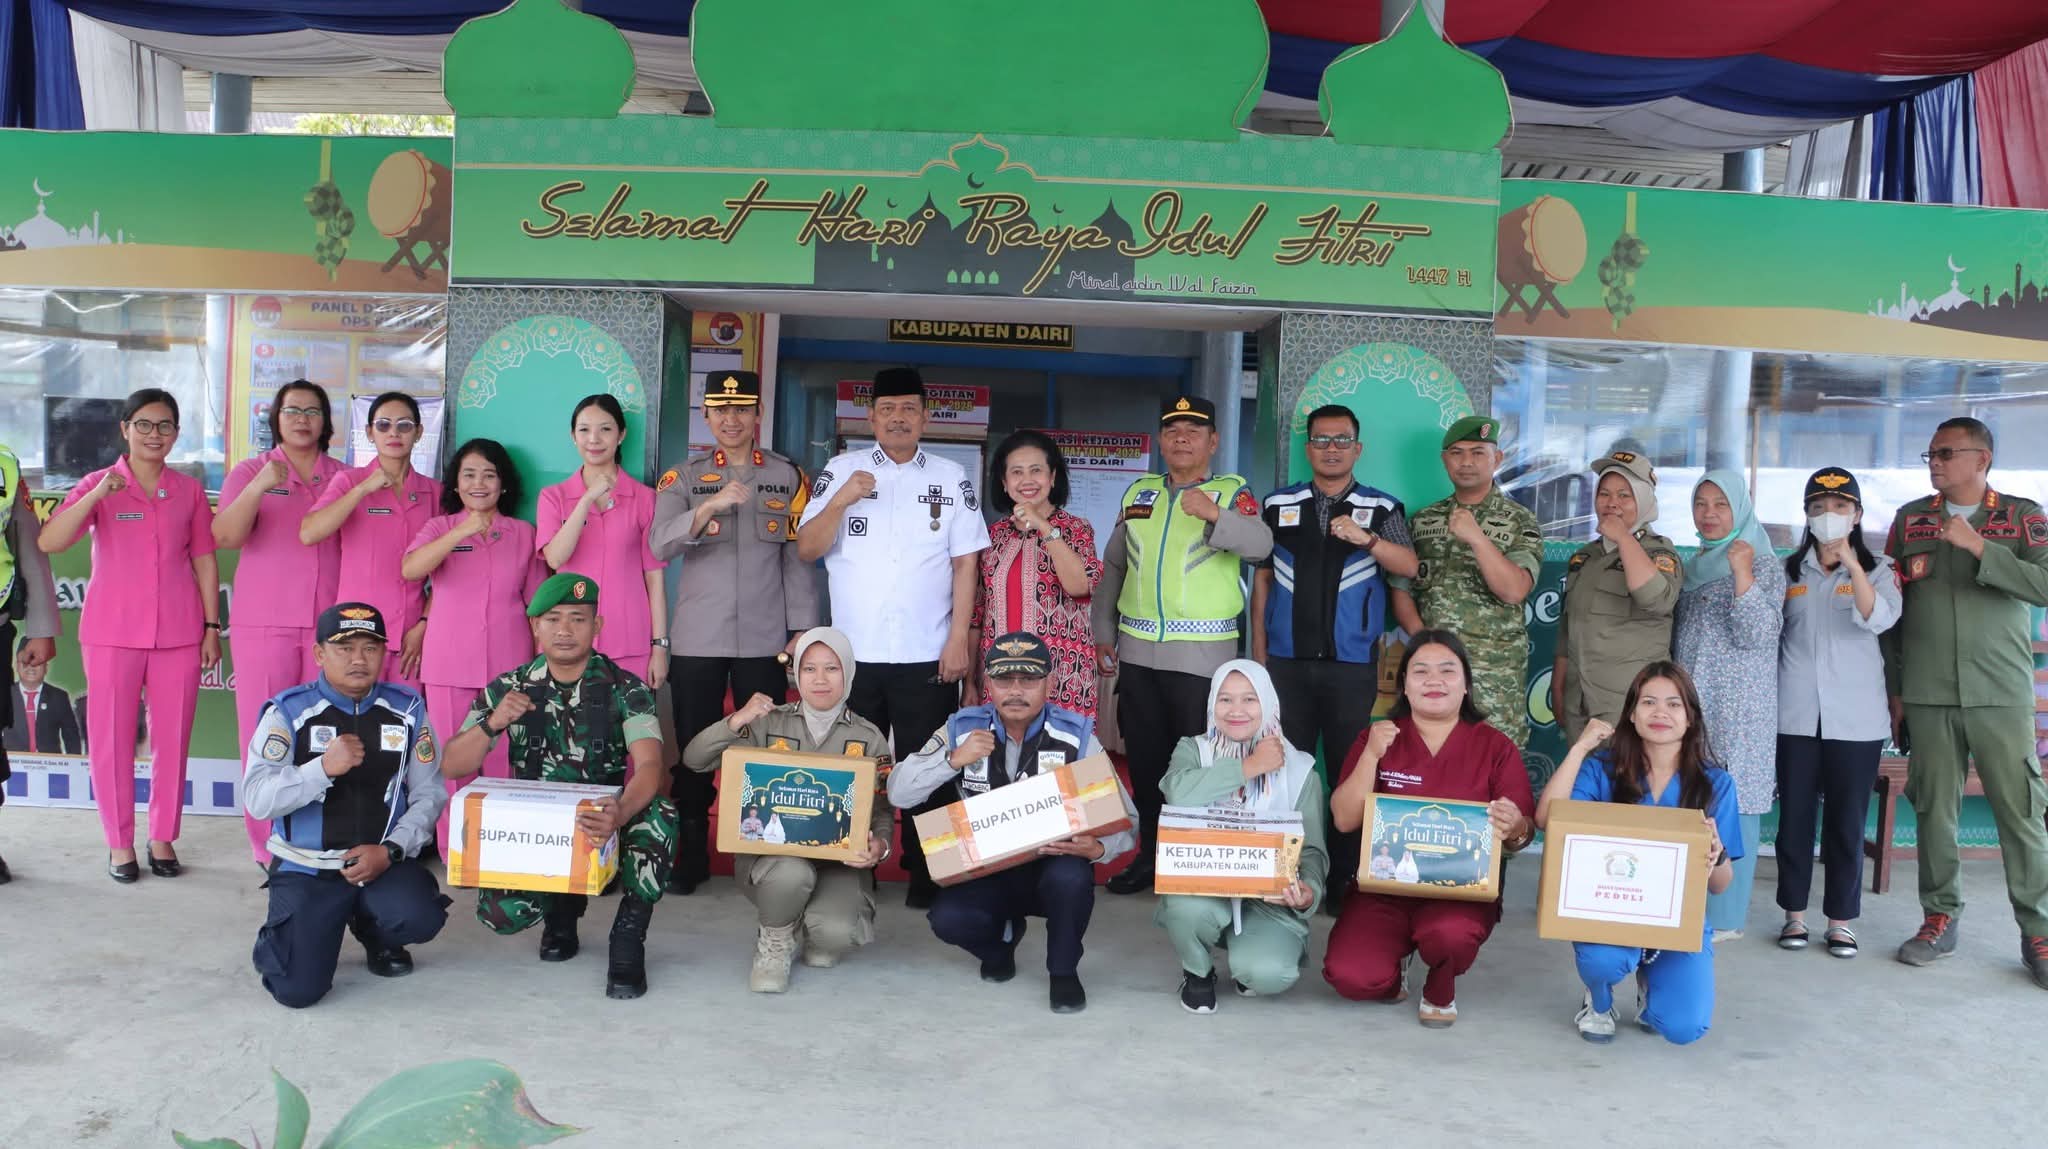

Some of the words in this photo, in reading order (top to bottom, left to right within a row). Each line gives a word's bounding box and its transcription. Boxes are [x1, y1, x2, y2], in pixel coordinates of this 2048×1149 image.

[521, 179, 817, 245] Selamat
[797, 184, 938, 246] Hari
[959, 192, 1111, 295] Raya
[1117, 190, 1269, 260] Idul
[1067, 270, 1120, 292] Minal
[1122, 275, 1164, 293] aidin
[1167, 277, 1205, 296] Wal
[1407, 266, 1447, 287] 1447
[1457, 269, 1472, 288] H
[311, 302, 358, 314] PANEL
[341, 316, 370, 328] OPS
[893, 320, 1010, 340] KABUPATEN
[1015, 325, 1069, 342] DAIRI
[931, 411, 957, 419] AIRI
[1082, 437, 1142, 447] KEJADIAN
[1090, 459, 1125, 467] DAIRI
[757, 484, 790, 495] POLRI
[922, 496, 951, 506] BUPATI
[1497, 532, 1510, 542] AD
[771, 791, 795, 806] Idul
[799, 793, 825, 809] Fitri
[970, 807, 1022, 832] BUPATI
[1025, 794, 1063, 815] DAIRI
[478, 828, 531, 844] BUPATI
[1404, 828, 1429, 843] Idul
[1433, 829, 1462, 846] Fitri
[1166, 846, 1213, 859] KETUA
[1218, 848, 1235, 859] TP
[1239, 848, 1268, 860] PKK
[1173, 861, 1231, 871] KABUPATEN
[1233, 862, 1259, 871] DAIRI
[1595, 890, 1644, 902] PEDULI
